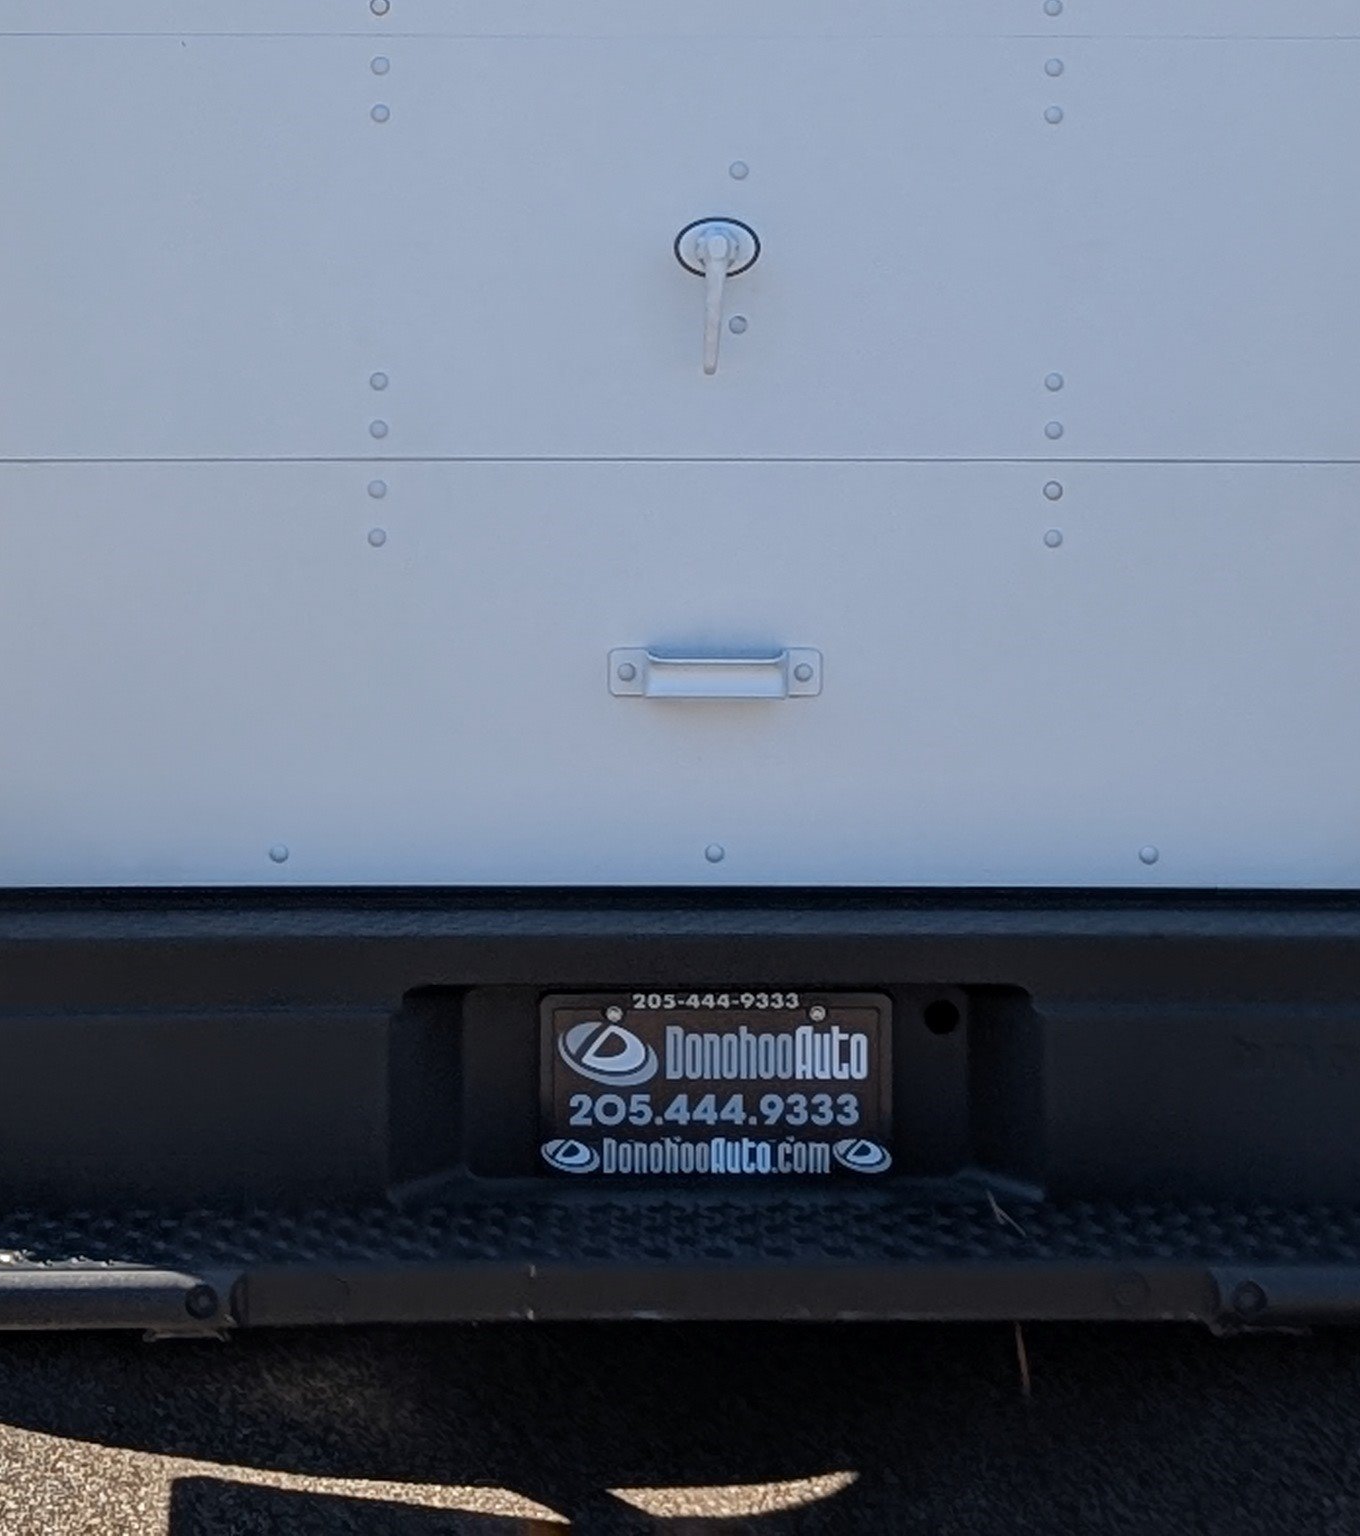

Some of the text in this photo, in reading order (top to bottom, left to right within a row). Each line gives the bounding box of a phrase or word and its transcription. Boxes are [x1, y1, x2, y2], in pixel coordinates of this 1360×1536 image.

[633, 993, 800, 1009] 205-444-9333
[665, 1026, 869, 1080] DonohooAuto
[569, 1093, 860, 1126] 205.444.9333
[603, 1138, 831, 1174] DonohooAuto.com
